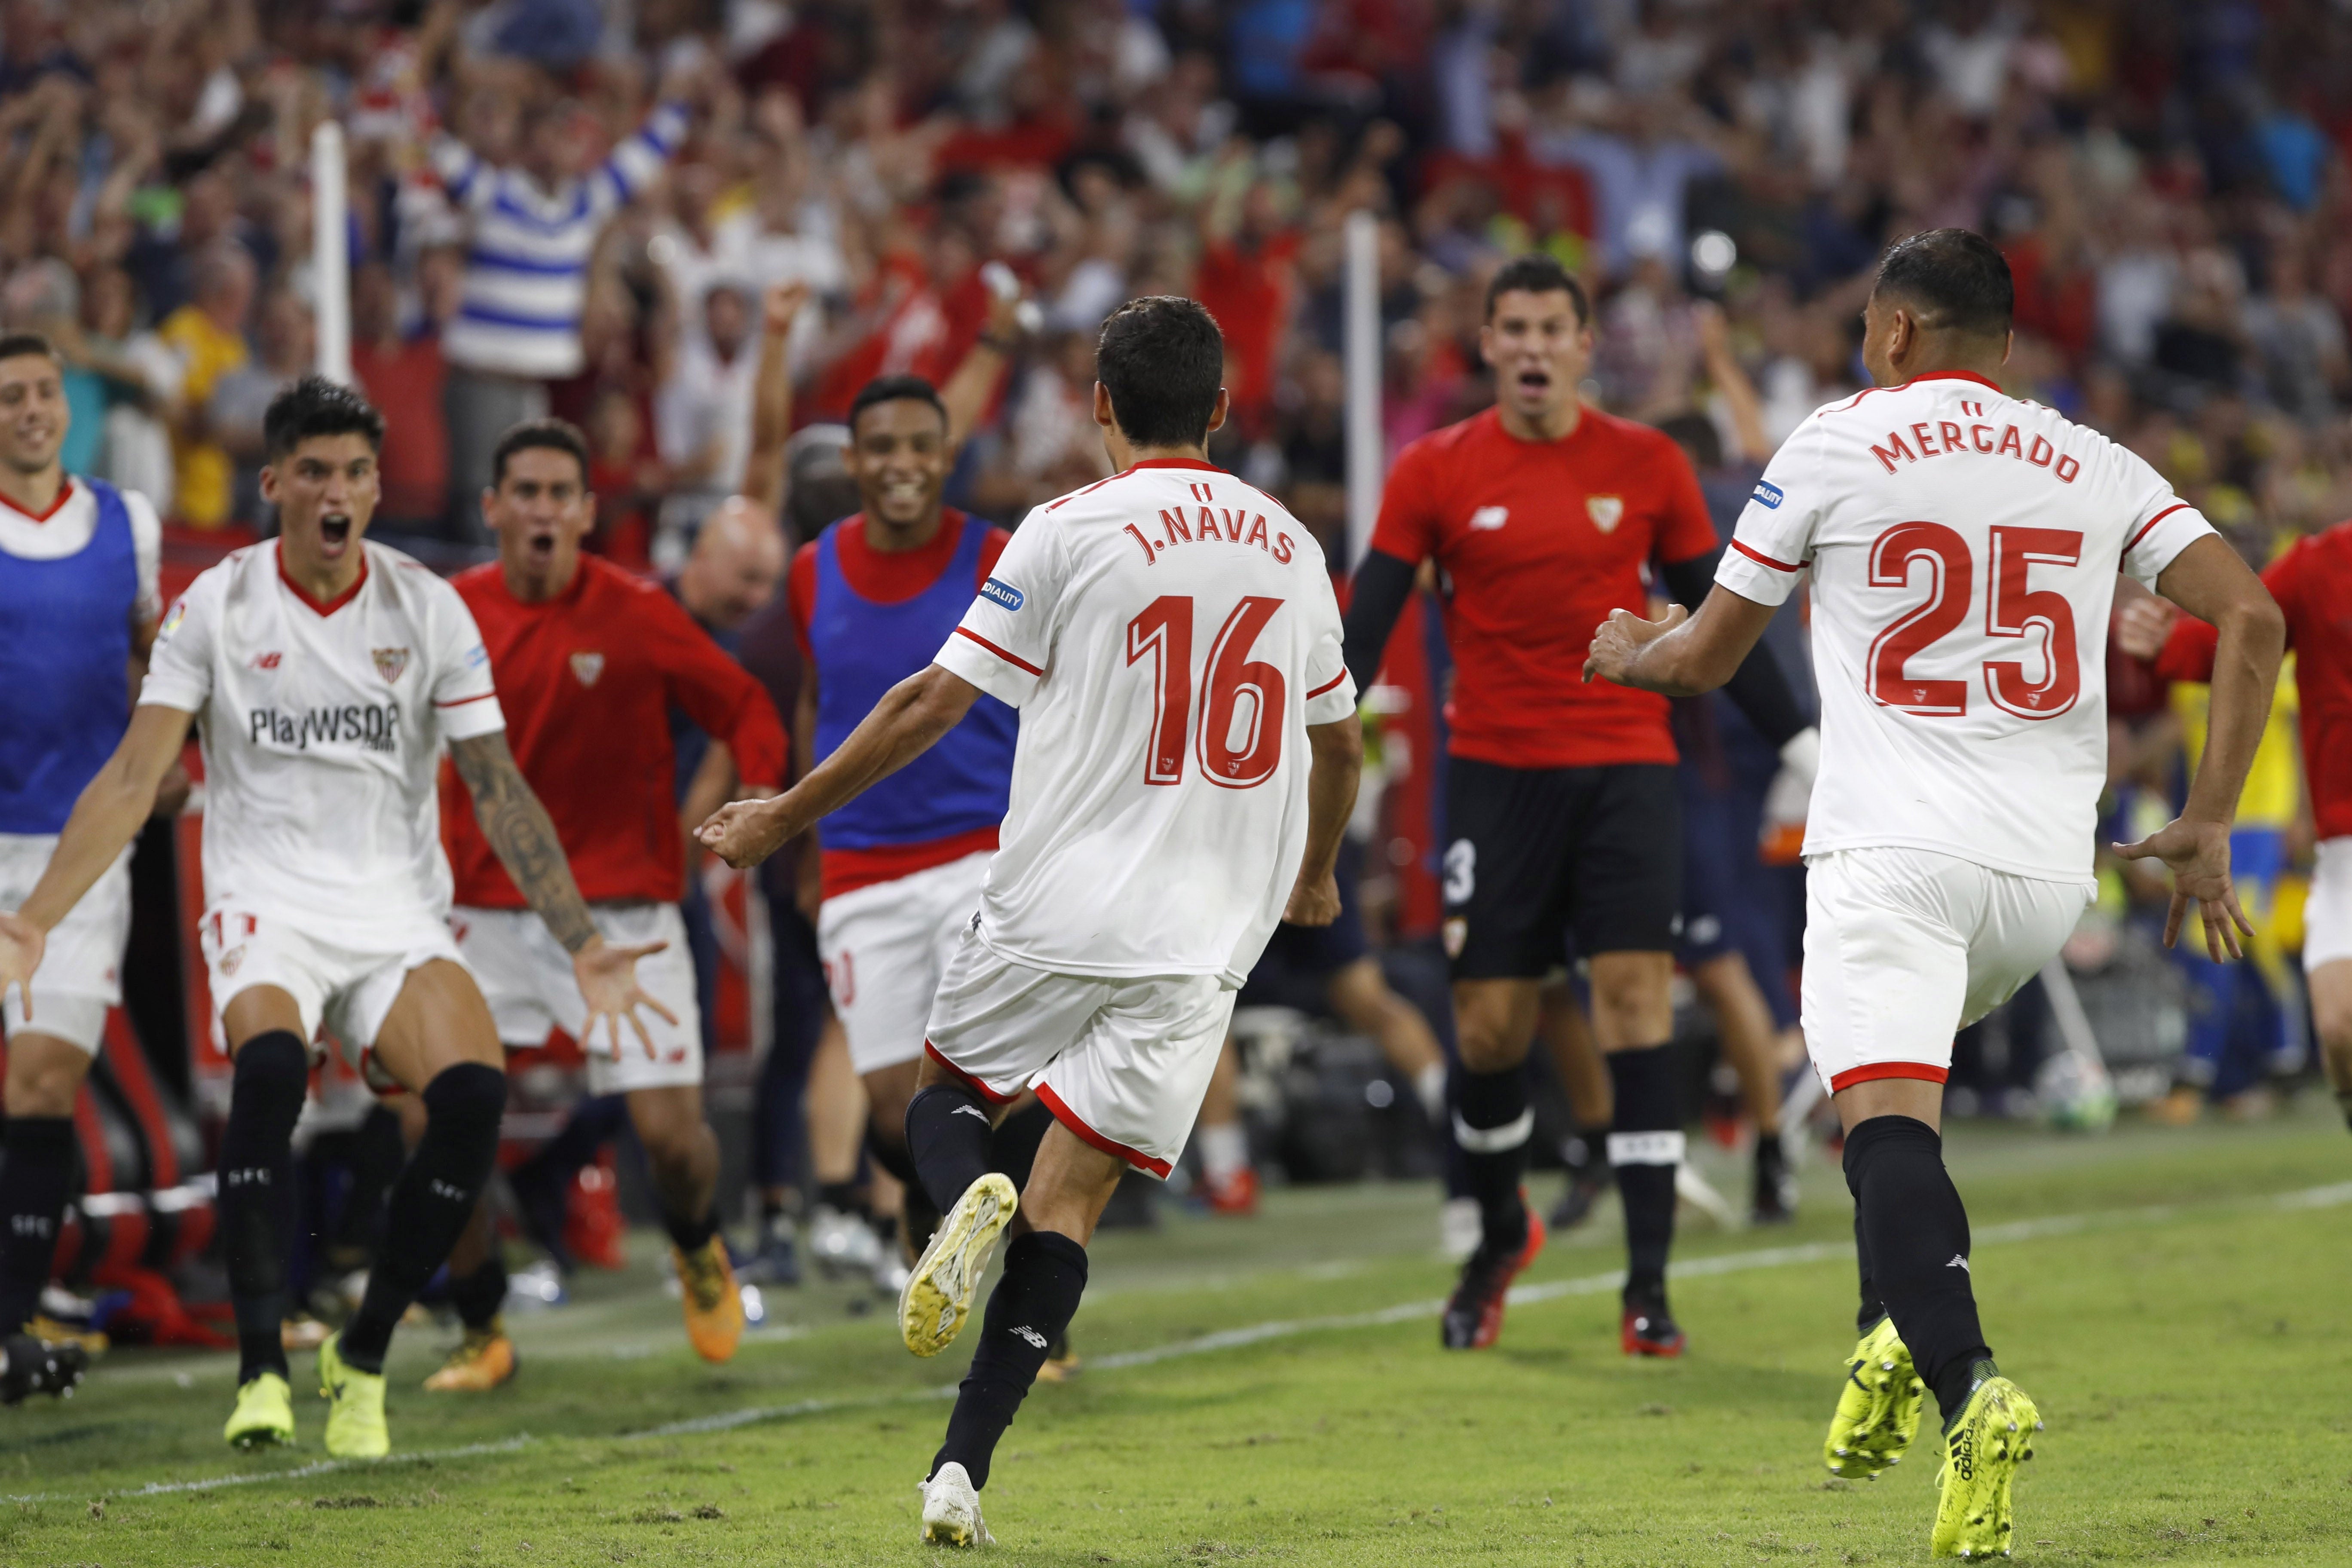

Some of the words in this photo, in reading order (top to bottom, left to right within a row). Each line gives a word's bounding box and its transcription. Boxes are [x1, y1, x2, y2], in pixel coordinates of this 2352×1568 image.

[1868, 421, 2080, 484] MERCADO
[1123, 506, 1295, 566] J.NAVAS
[981, 582, 1021, 606] DIALITY
[1865, 521, 2084, 721] 25
[1127, 595, 1286, 790] 16
